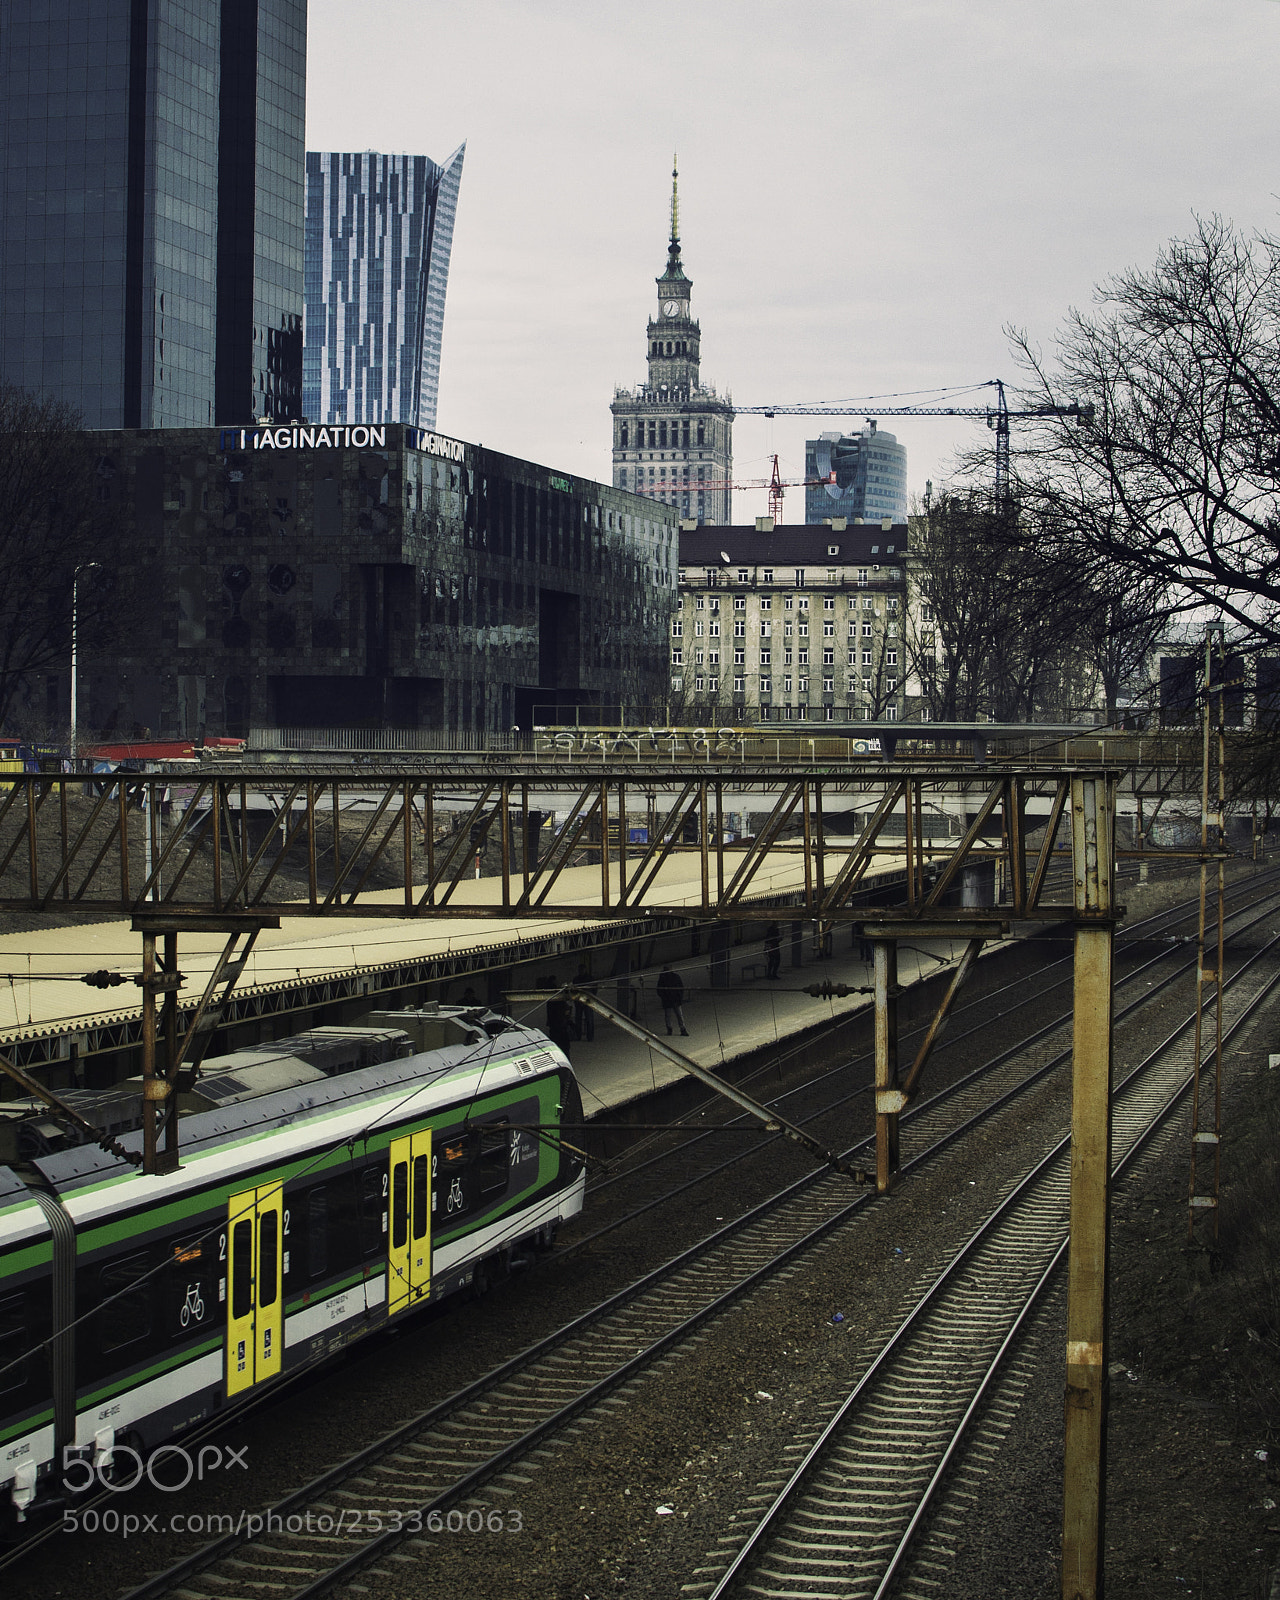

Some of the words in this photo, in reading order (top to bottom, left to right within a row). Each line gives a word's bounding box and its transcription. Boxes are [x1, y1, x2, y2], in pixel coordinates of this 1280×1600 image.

[432, 1155, 438, 1178] 2
[382, 1173, 388, 1197] 2
[283, 1209, 290, 1236] 2
[219, 1233, 226, 1261] 2
